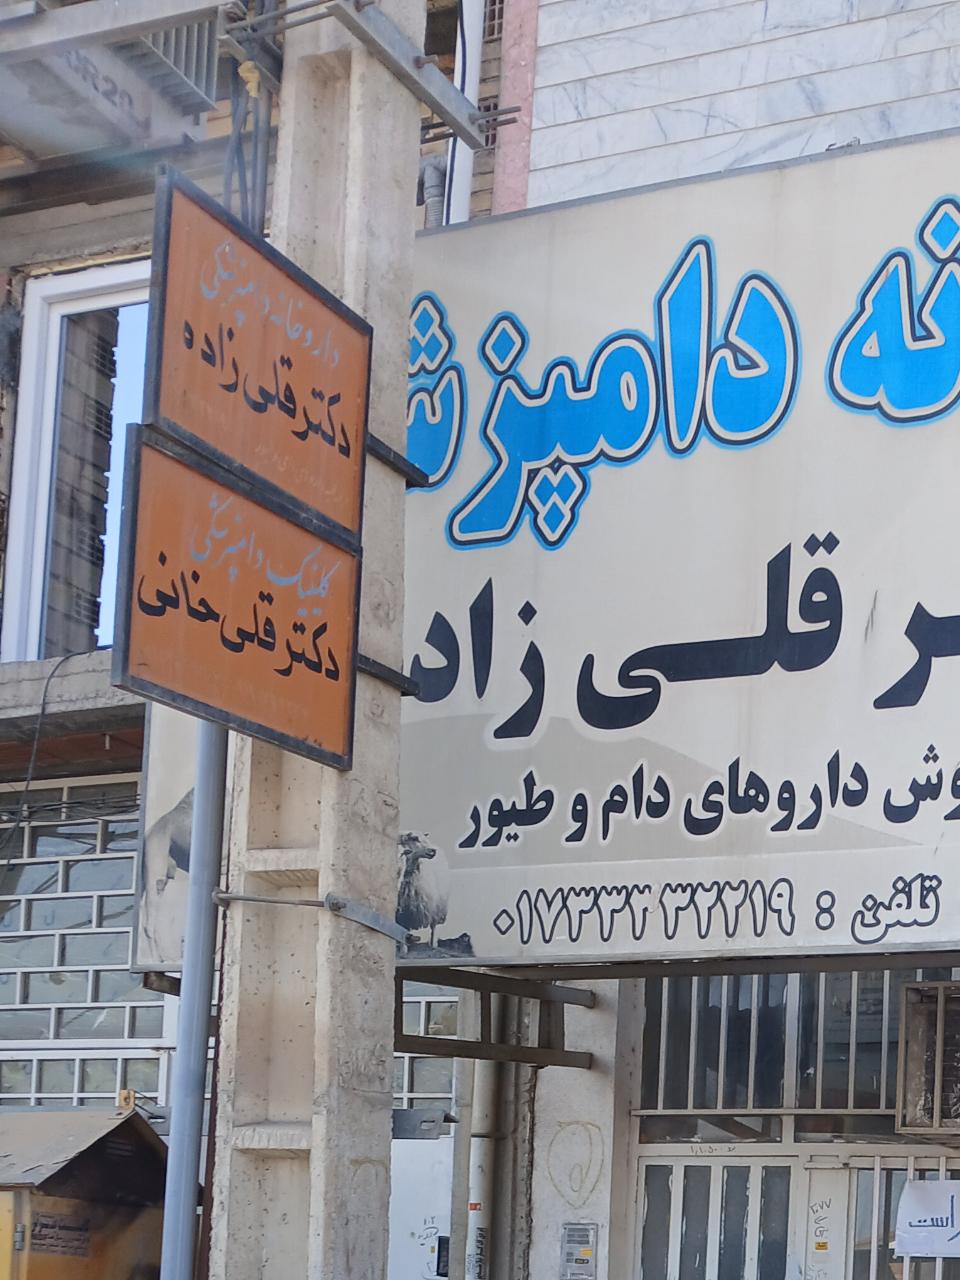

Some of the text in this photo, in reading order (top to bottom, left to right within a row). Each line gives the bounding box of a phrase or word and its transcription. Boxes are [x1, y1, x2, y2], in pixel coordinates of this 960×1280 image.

[182, 319, 351, 459] دکتر قلی زاده
[136, 550, 341, 682] دکتر قلی خانی
[403, 577, 546, 739] زاد
[576, 530, 844, 731] قلی
[457, 768, 554, 850] طیور
[567, 793, 591, 844] و
[600, 761, 671, 840] دام
[683, 749, 869, 838] داروهای
[850, 873, 942, 944] تلفن
